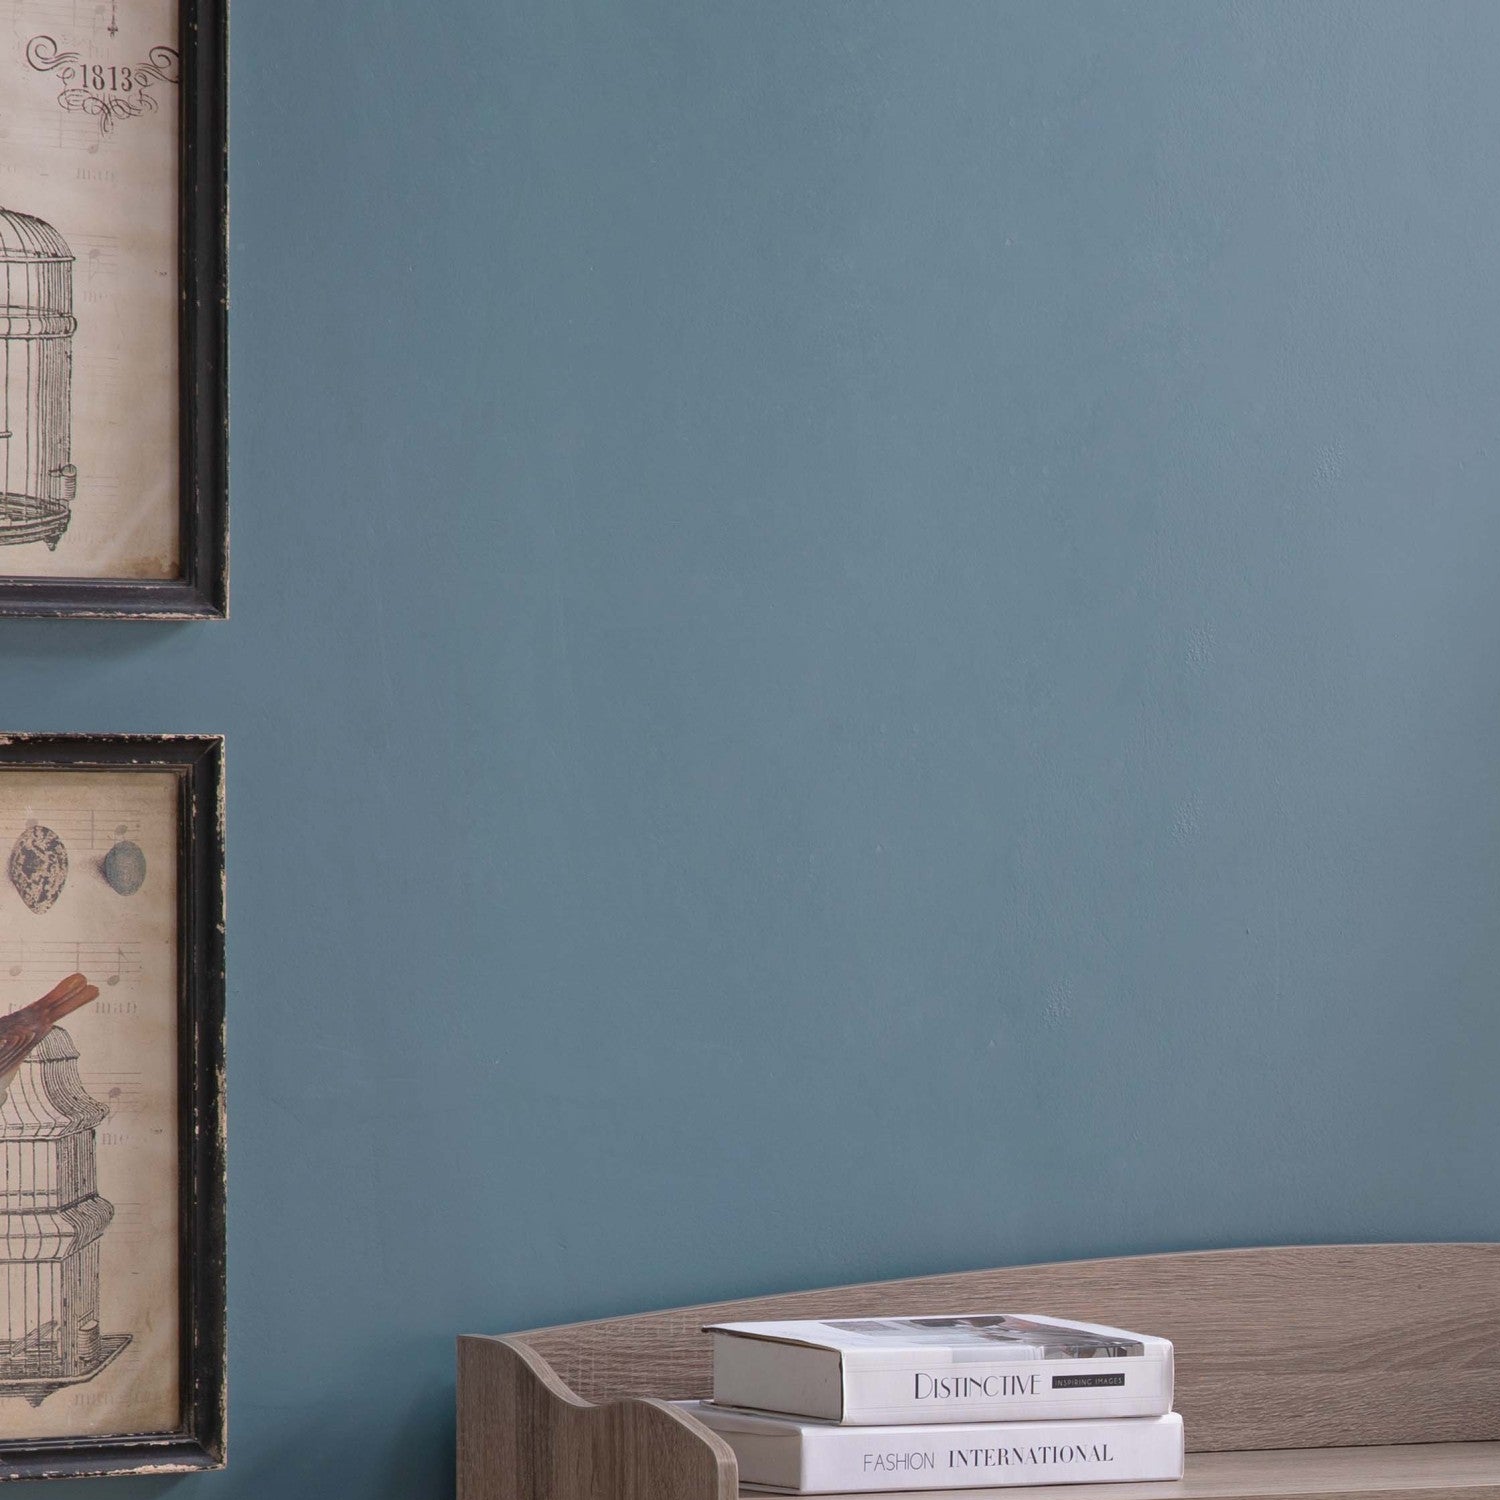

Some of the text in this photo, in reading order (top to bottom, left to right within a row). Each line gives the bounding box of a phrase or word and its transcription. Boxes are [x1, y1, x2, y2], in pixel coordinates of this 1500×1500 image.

[80, 64, 133, 91] 1813
[915, 1373, 1041, 1399] DISTINCTIVE
[1055, 1376, 1123, 1387] INSPIRING IMAGES
[863, 1444, 1114, 1473] FASHION INTERNATIONAL
